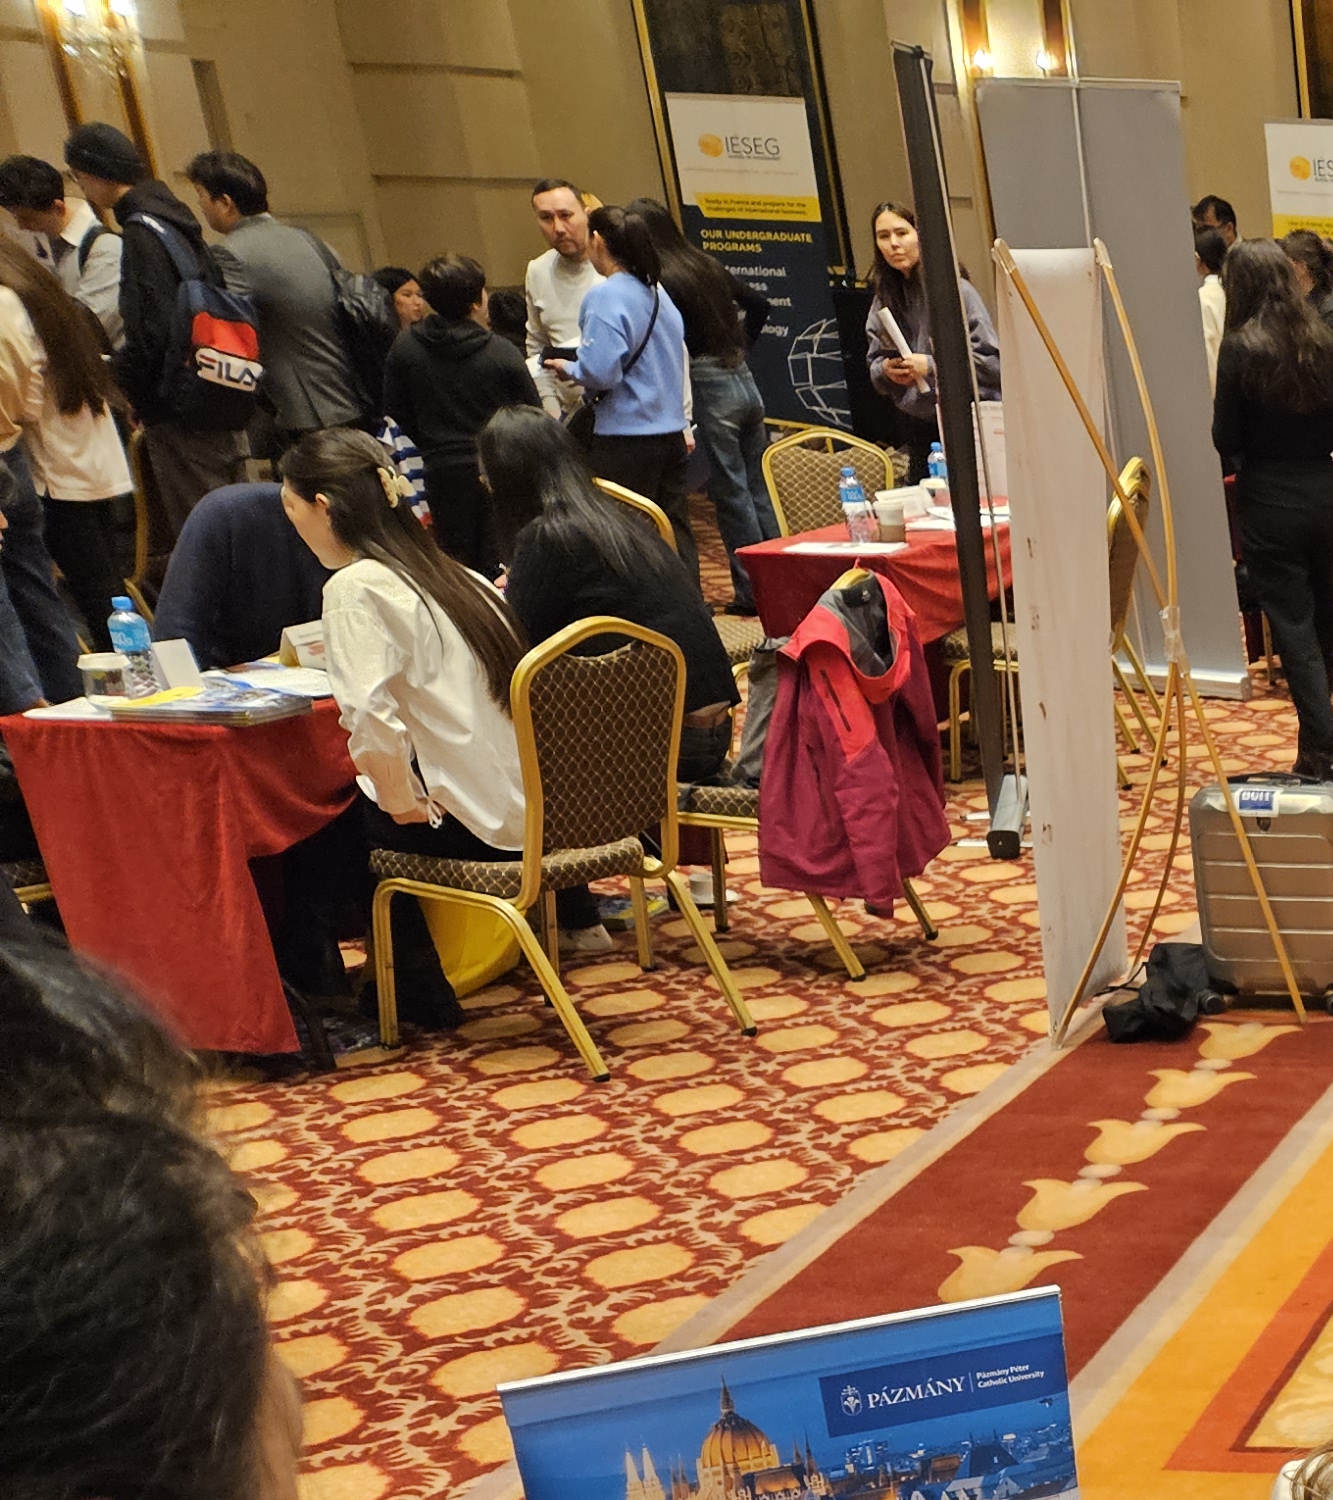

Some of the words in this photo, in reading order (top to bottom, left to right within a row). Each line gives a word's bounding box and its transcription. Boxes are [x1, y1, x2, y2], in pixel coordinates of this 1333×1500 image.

[701, 228, 723, 240] OUR
[725, 229, 813, 243] UNDERGRADUATE
[702, 241, 763, 253] PROGRAMS
[199, 354, 257, 387] FILA
[976, 1365, 1009, 1379] Pázmány
[1010, 1363, 1030, 1374] Péter
[978, 1378, 1008, 1388] Catholic
[1008, 1371, 1044, 1384] University
[868, 1376, 965, 1409] PÁZMÁNY
